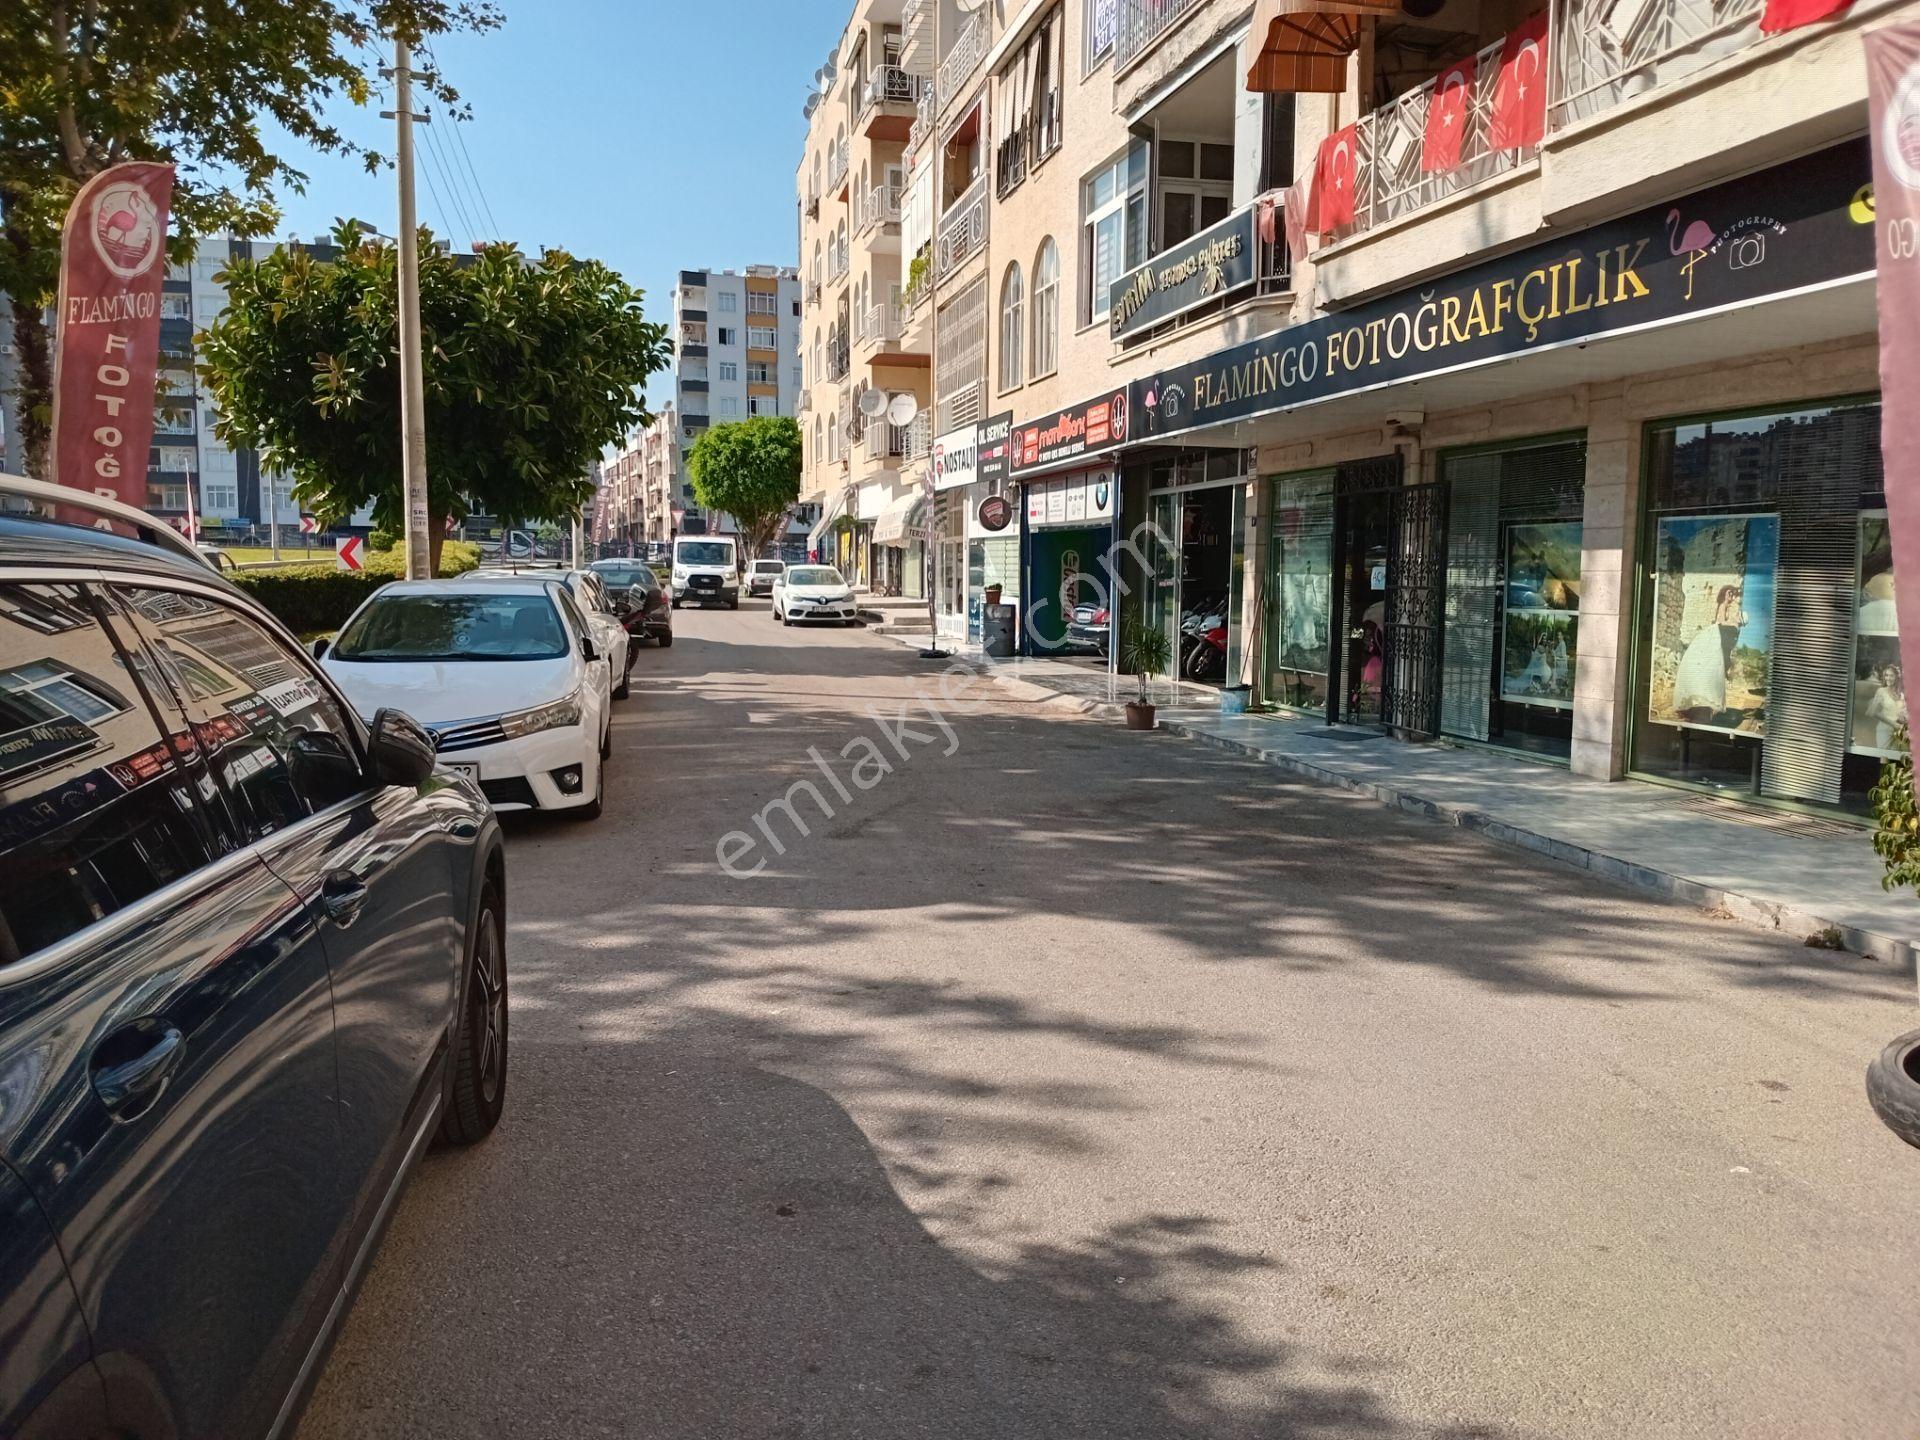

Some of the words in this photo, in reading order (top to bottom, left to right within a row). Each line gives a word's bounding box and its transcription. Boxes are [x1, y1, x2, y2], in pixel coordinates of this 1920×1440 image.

[1710, 216, 1787, 254] PHOTOGRAPHY
[1193, 341, 1319, 411] FLAMİNGO
[1325, 238, 1650, 376] FOTOĞRAFÇILIK
[986, 421, 1008, 442] SERVICE
